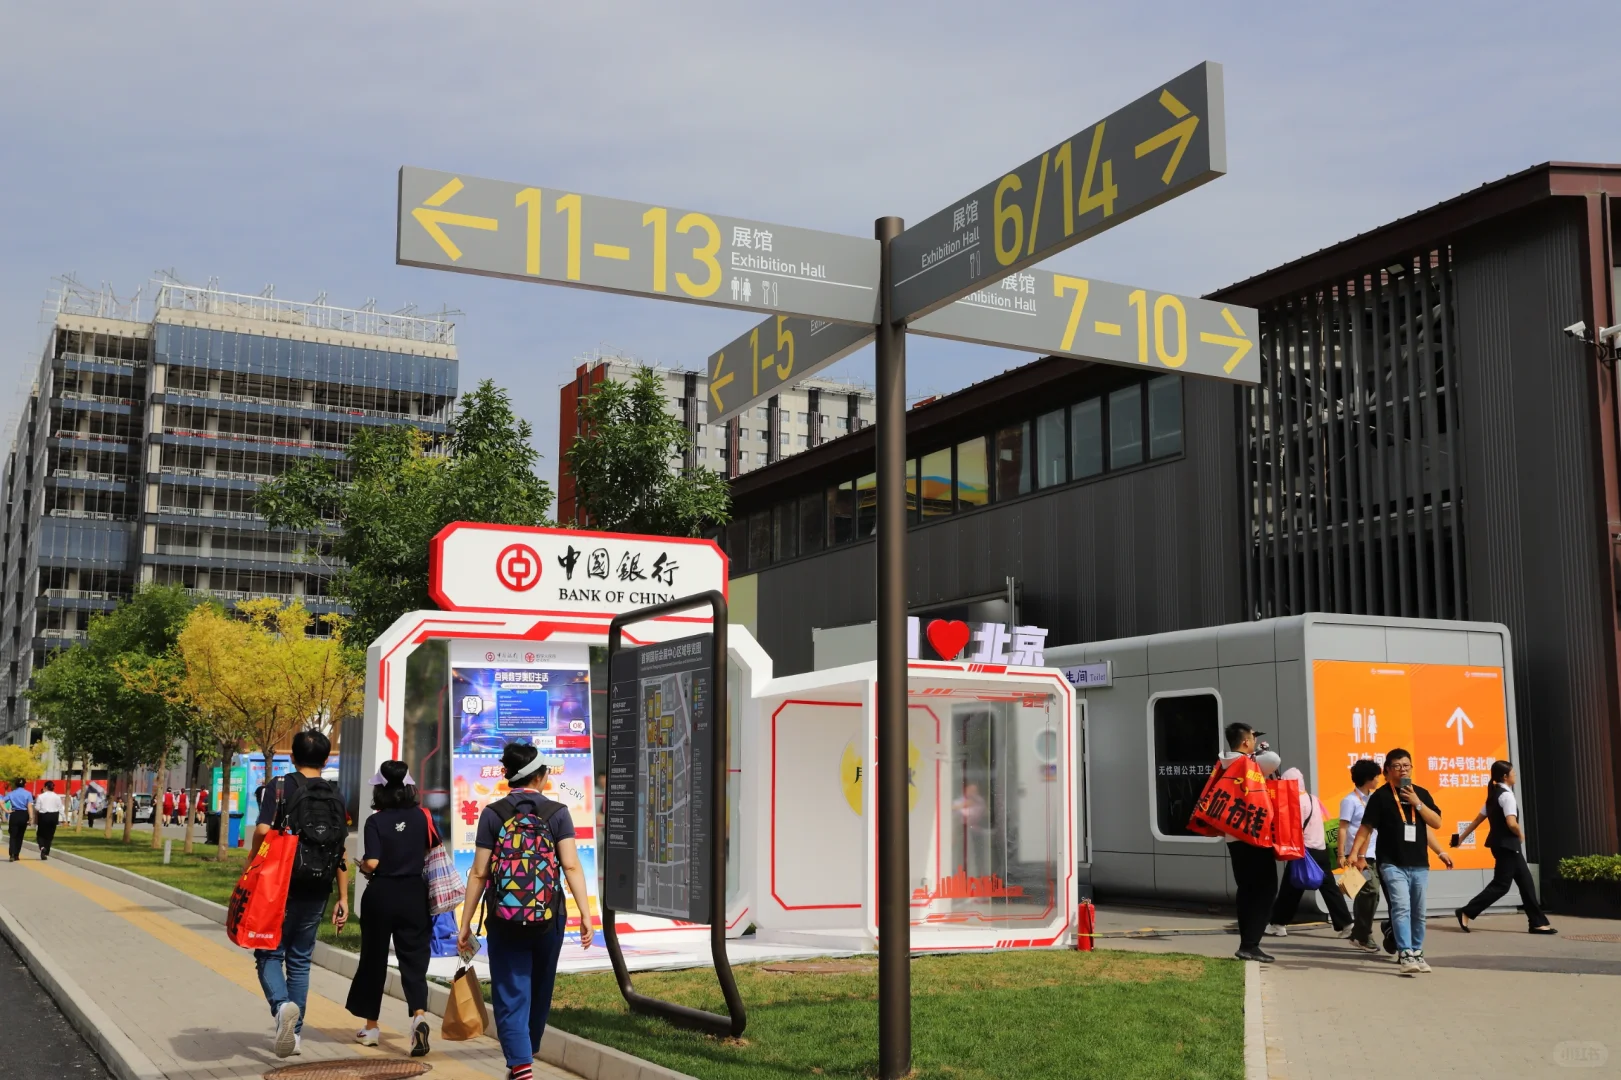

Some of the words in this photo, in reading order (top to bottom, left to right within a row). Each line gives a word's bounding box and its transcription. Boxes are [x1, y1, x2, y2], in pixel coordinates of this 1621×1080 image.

[993, 120, 1118, 267] 6/14
[952, 200, 979, 233] 展馆
[514, 187, 722, 298] 11-13
[731, 226, 773, 252] 展馆
[921, 239, 961, 268] Exhibition
[962, 226, 980, 247] Hall
[731, 252, 796, 274] Exhibition
[800, 262, 826, 278] Hall
[1001, 272, 1035, 295] 展馆
[1014, 296, 1036, 312] Hall
[1053, 274, 1188, 368] 7-10
[749, 315, 795, 397] 1-5
[558, 588, 601, 602] BANK
[605, 590, 625, 603] OF
[974, 622, 1048, 667] 北京
[1158, 765, 1216, 776] 无性别公共卫生
